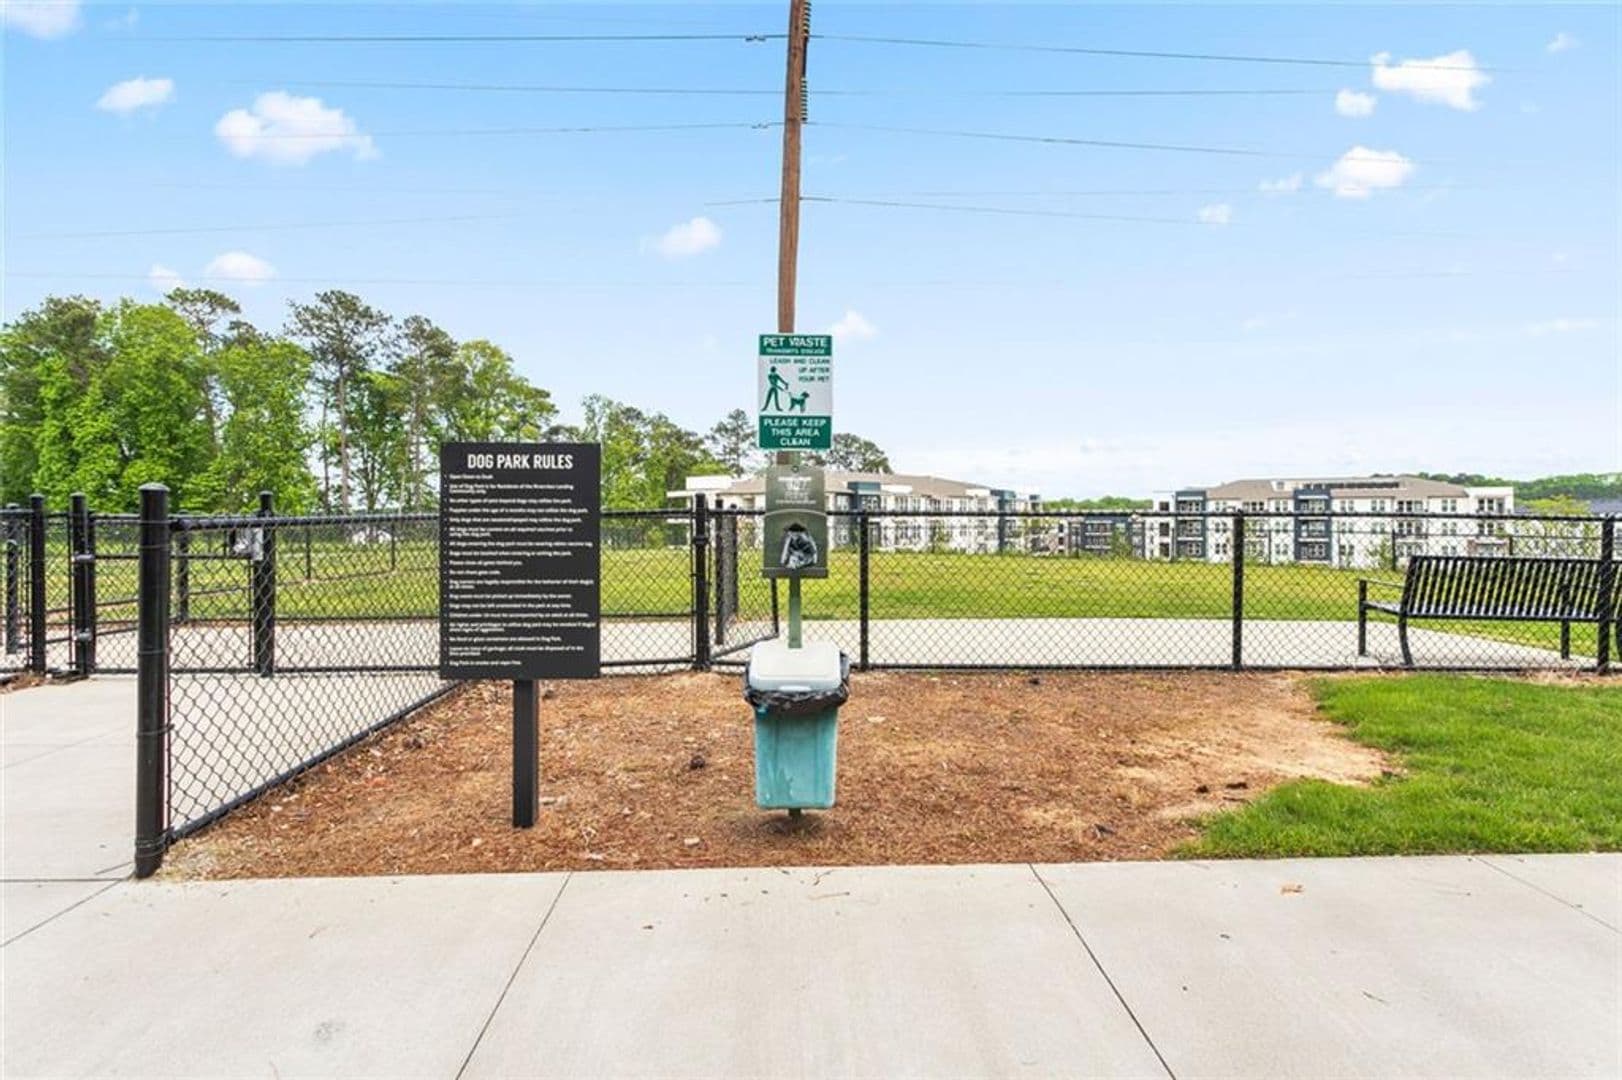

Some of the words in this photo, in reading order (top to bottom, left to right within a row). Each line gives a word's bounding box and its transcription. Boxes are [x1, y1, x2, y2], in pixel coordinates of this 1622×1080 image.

[763, 337, 784, 347] PET
[789, 337, 827, 347] WASTE
[764, 418, 798, 426] PLEASE
[802, 418, 827, 426] KEEP
[771, 428, 792, 437] THIS
[795, 428, 820, 437] AREA
[780, 437, 811, 446] CLEAN
[467, 454, 494, 469] DOG
[496, 454, 530, 469] PARK
[533, 454, 574, 469] RULES
